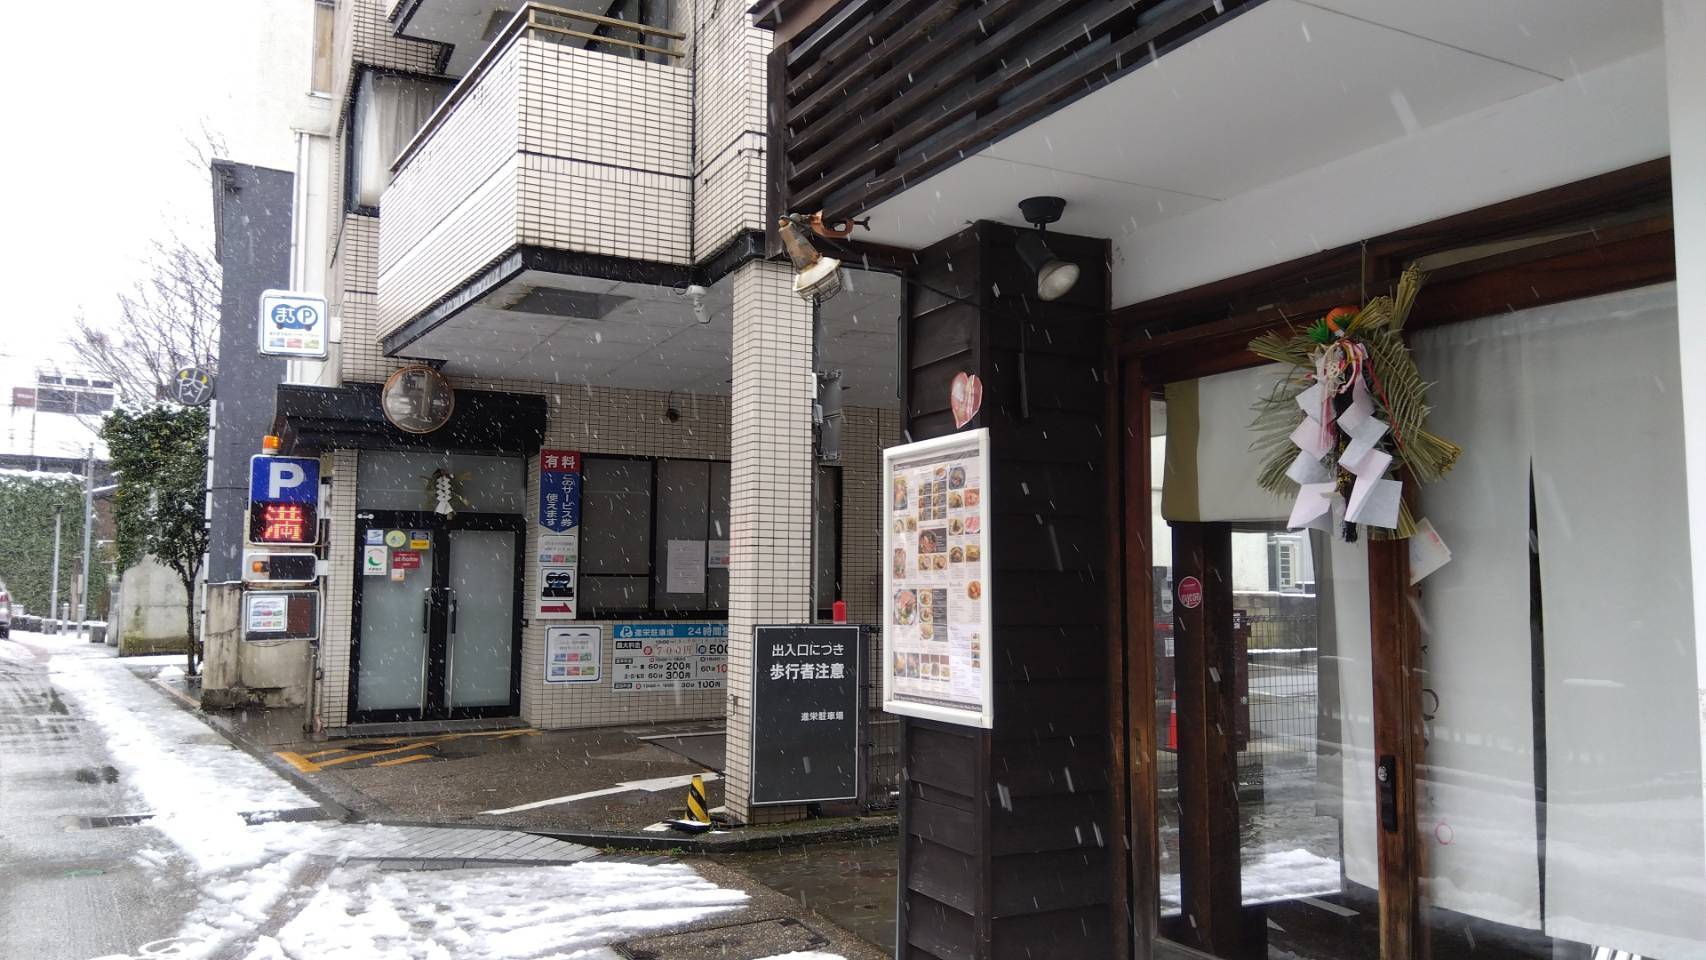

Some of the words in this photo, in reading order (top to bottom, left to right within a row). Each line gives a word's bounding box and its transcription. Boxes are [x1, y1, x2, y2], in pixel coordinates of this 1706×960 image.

[545, 455, 576, 469] 有料
[268, 462, 304, 499] P
[546, 493, 559, 526] 使えます
[560, 474, 574, 527] このサービス券
[264, 504, 304, 540] 満
[772, 643, 845, 657] 出入口につき
[770, 663, 845, 680] 歩行者注意
[801, 711, 844, 722] 進栄駐車場
